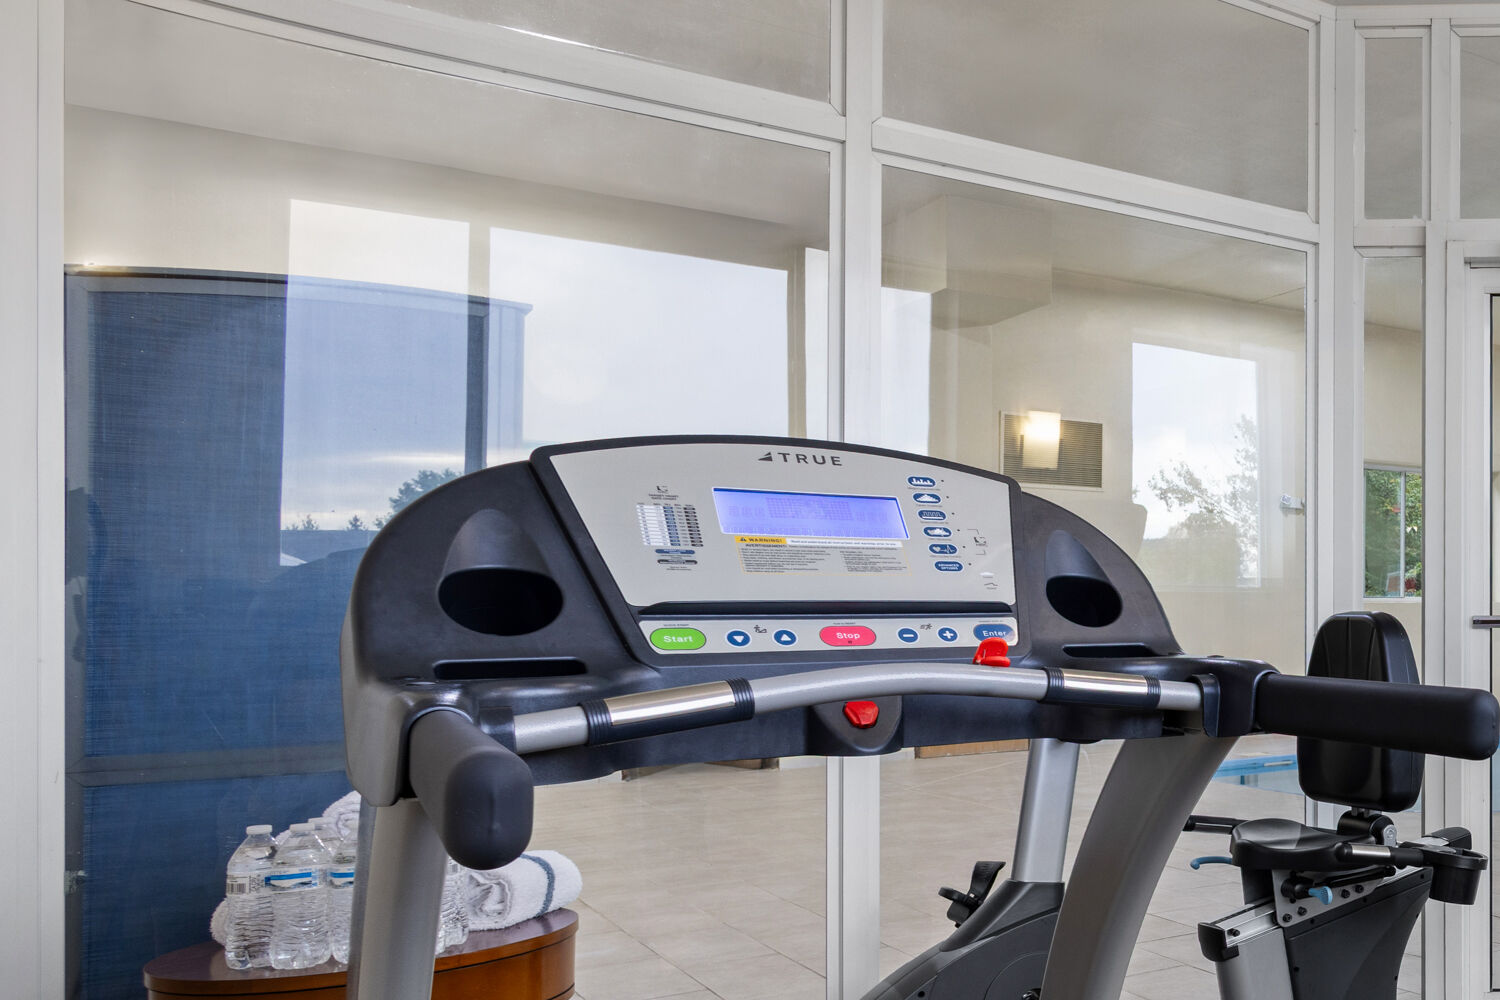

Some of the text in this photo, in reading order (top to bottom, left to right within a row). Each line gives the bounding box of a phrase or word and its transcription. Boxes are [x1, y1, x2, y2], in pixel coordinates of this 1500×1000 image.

[777, 452, 842, 466] TRUE
[663, 635, 693, 643] Start
[835, 632, 861, 640] Stop
